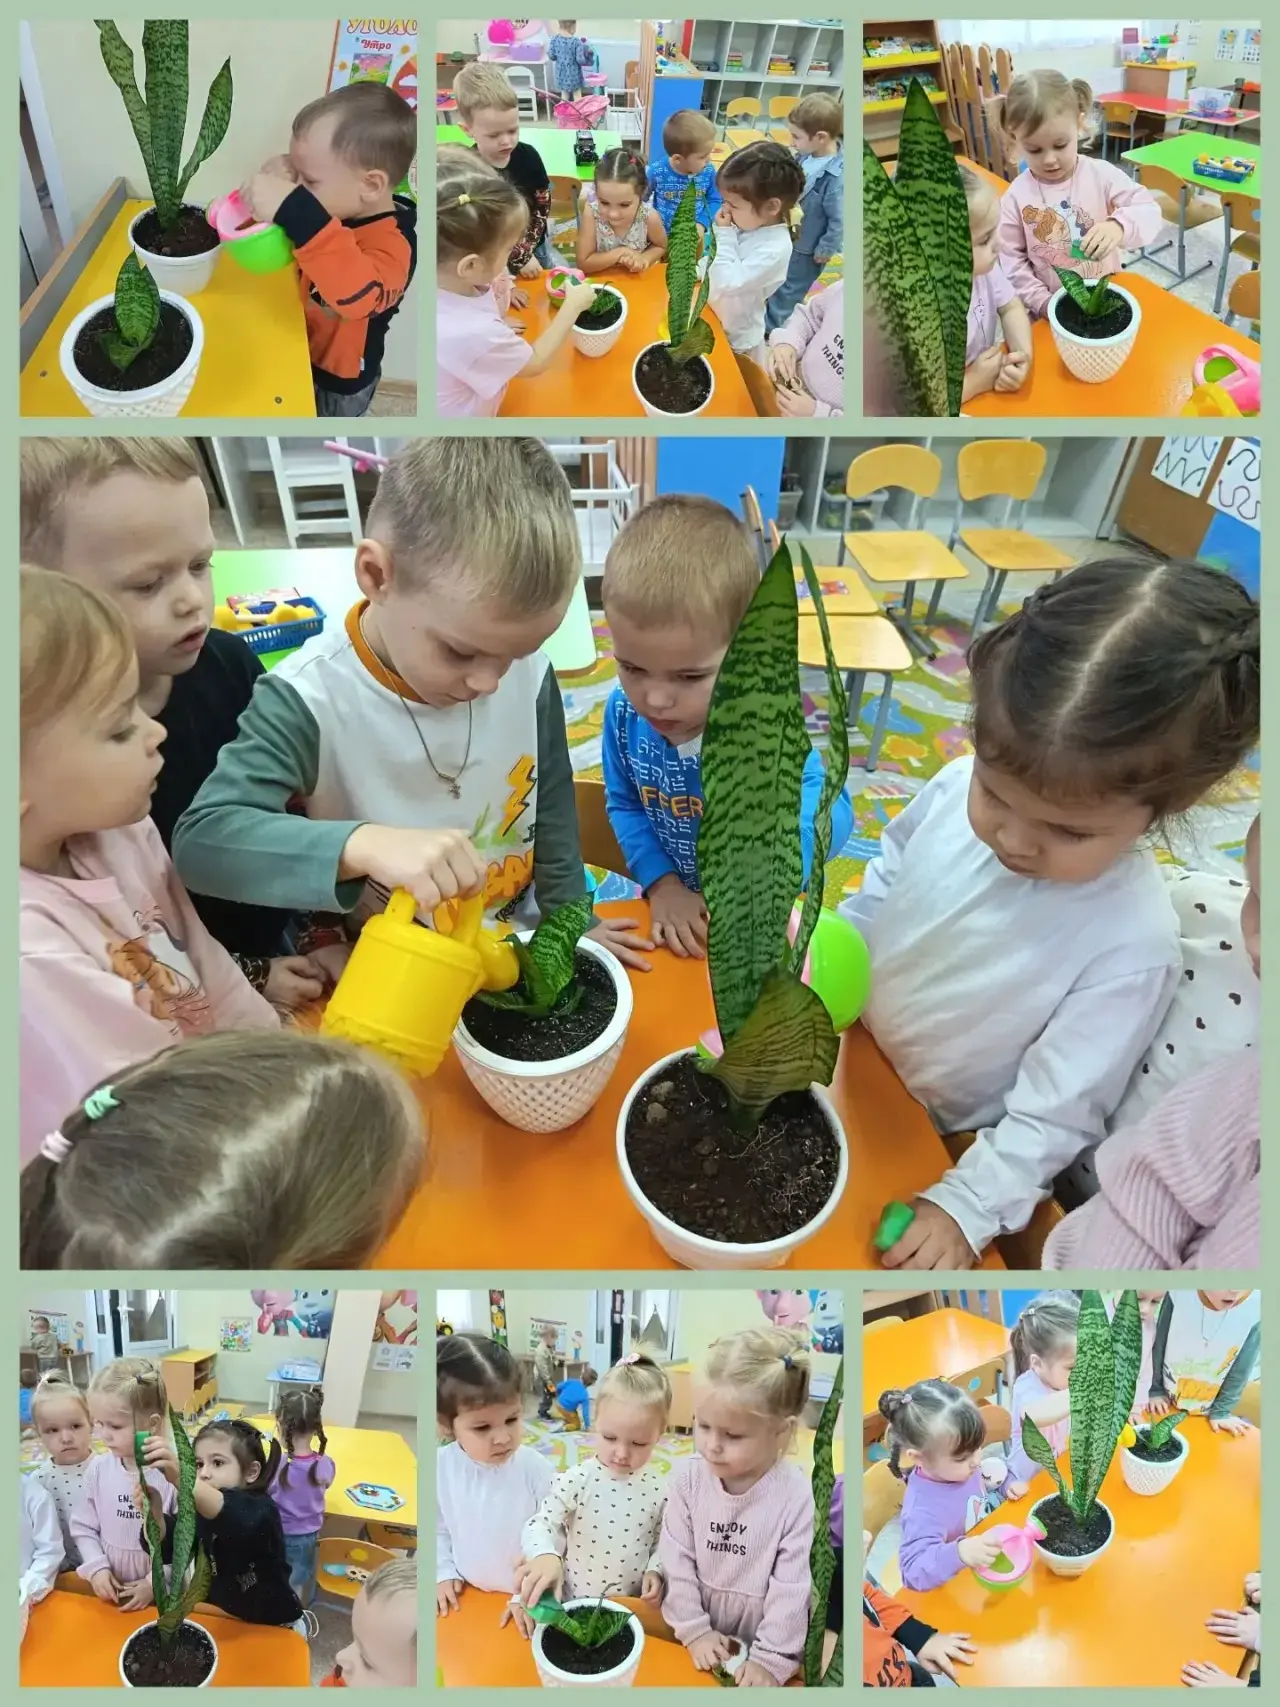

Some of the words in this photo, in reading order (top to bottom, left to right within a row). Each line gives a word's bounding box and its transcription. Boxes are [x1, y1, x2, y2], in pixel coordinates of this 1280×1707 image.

[360, 39, 392, 51] Утро
[821, 344, 845, 381] THING
[710, 1521, 748, 1535] ENJOY
[706, 1539, 747, 1556] THINGS
